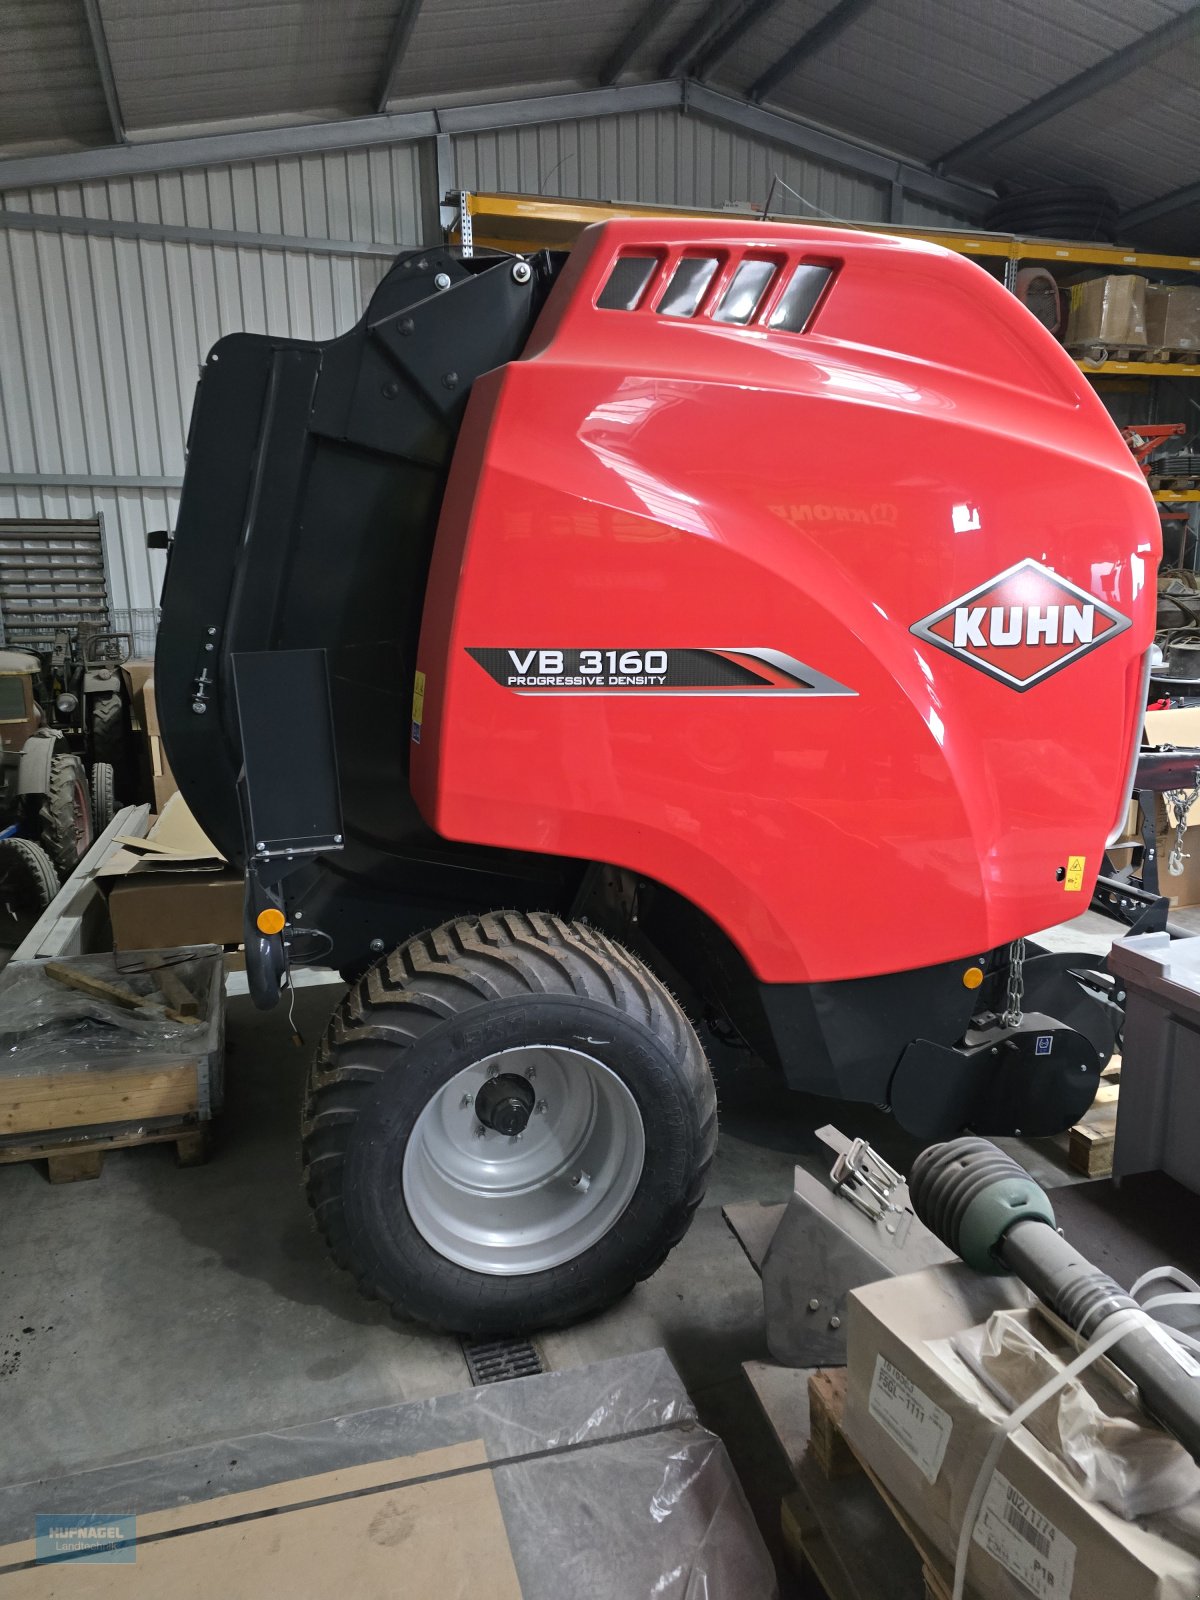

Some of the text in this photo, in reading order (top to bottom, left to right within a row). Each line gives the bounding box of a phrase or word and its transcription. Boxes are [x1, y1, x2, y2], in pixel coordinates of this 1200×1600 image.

[953, 604, 1095, 648] KUHN
[508, 650, 668, 675] VB 3160
[508, 676, 667, 686] PROGRESSIVE DENSITY
